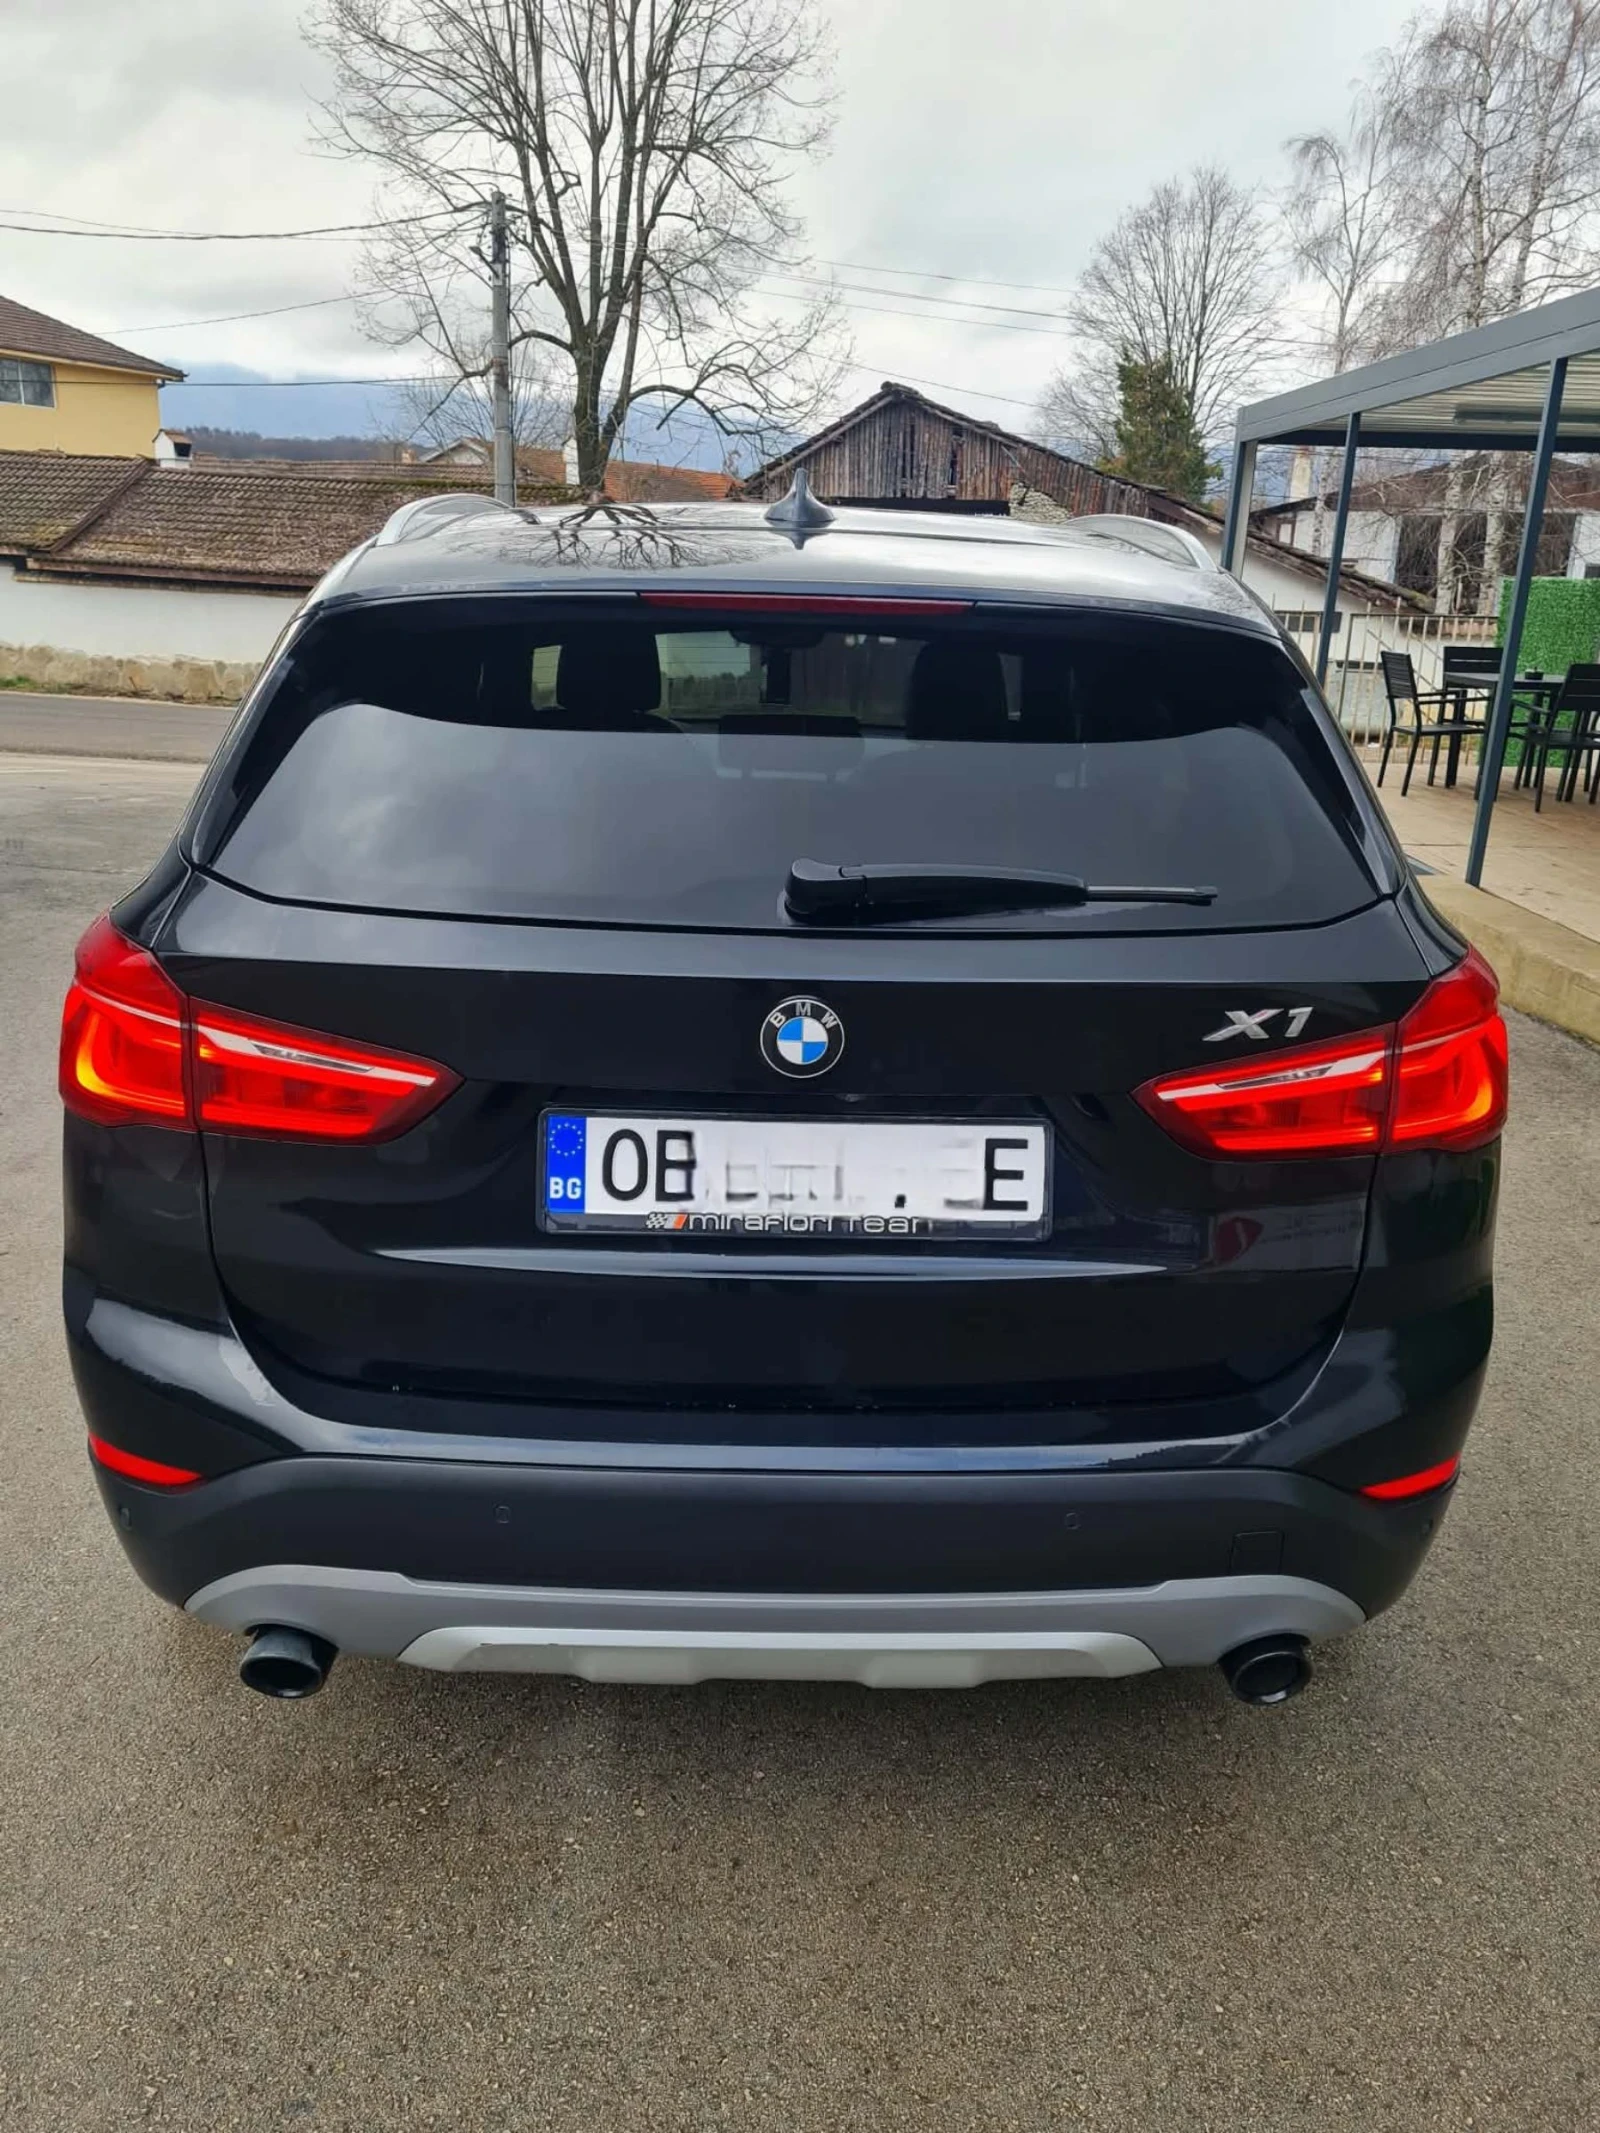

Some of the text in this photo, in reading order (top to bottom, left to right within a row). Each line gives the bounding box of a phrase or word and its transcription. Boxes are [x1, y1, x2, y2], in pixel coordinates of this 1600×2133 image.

[769, 1001, 838, 1029] BMW
[1201, 1006, 1314, 1042] X1
[549, 1176, 582, 1200] BG
